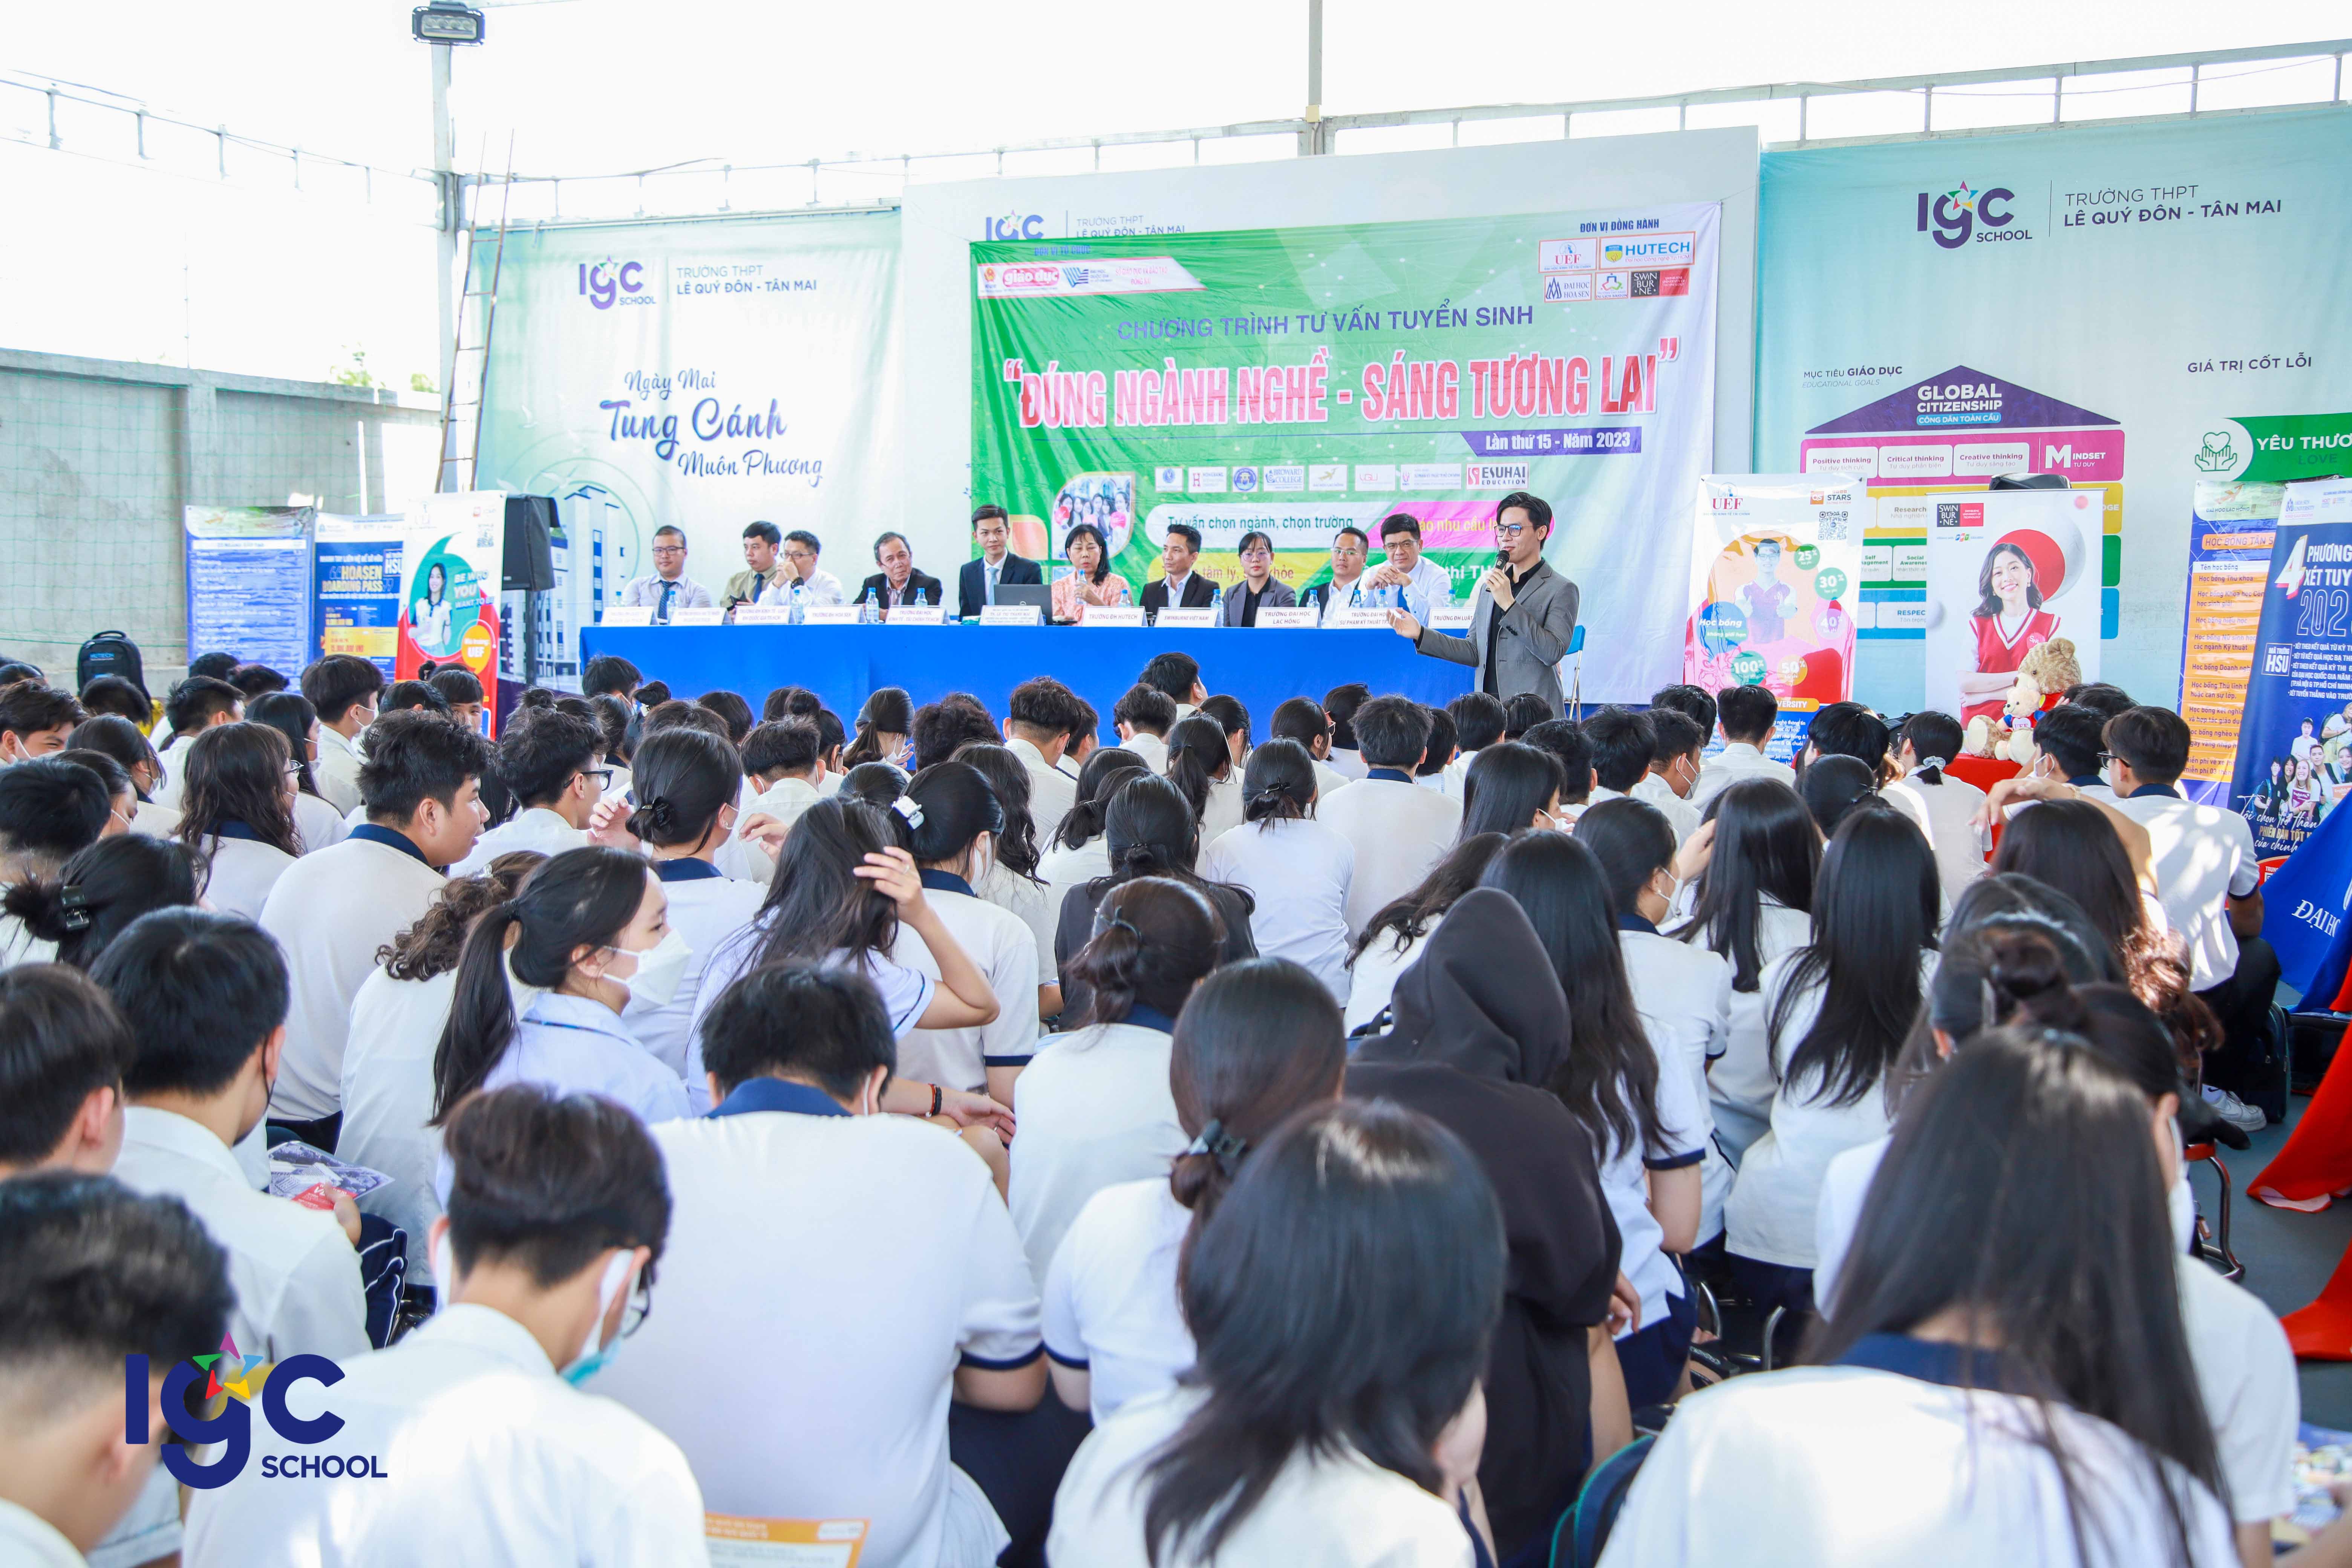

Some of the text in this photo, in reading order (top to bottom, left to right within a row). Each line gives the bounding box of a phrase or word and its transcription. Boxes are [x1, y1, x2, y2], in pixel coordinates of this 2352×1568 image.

[2065, 185, 2199, 207] TRƯỜNG THPT
[2064, 199, 2282, 227] LÊ QUÝ ĐÔN TÂN MAI
[1076, 216, 1144, 227] TRƯỜNG THPT
[1580, 217, 1659, 233] ĐƠN VỊ ĐỒNG HÀNH
[1091, 225, 1184, 238] QUÝ ĐÔN TÂN MAI
[1976, 230, 2032, 242] SCHOOL
[1626, 242, 1690, 256] HUTECH
[1555, 254, 1581, 264] UEF
[677, 265, 763, 278] TRƯỜNG THPT
[677, 279, 816, 294] LÊ QUÝ ĐÔN TÂN MAI
[620, 296, 656, 306] SCHOOL
[1118, 299, 1533, 340] CHƯƠNG TRÌNH TƯ VẤN TUYỂN SINH
[2187, 352, 2311, 373] GIÁ TRỊ CỐT LỖI
[1803, 366, 1902, 380] MỤC TIÊU GIÁO DỤC
[625, 368, 716, 400] Ngày Mai
[1115, 357, 1228, 427] NGÀNH
[1237, 346, 1329, 424] NGHỀ
[1337, 390, 1352, 404] -
[1362, 349, 1459, 421] SÁNG
[1467, 351, 1590, 418] TƯƠNG
[1918, 384, 2001, 400] GLOBAL
[1917, 400, 2002, 413] CITIZENSHIP
[1940, 415, 1958, 423] DÂN
[1960, 413, 1978, 422] TOÀN
[1980, 413, 1998, 422] CẦU
[600, 398, 787, 461] Tung Cánh
[1486, 432, 1630, 450] Lần thứ 15 Năm 2023
[2257, 435, 2294, 451] YÊU
[2298, 454, 2337, 465] LOVE
[678, 449, 822, 487] Muôn Phương
[1482, 467, 1526, 479] ESUHAI
[1712, 498, 1743, 510] UEF
[1209, 515, 1353, 531] chọn ngành, chọn trường
[1438, 514, 1485, 531] nhu cầu
[341, 566, 383, 580] HOASEN
[1203, 566, 1223, 579] tâm
[2274, 534, 2308, 597] 4
[454, 574, 466, 584] BE
[2303, 565, 2323, 586] XÉT
[322, 580, 383, 592] BOARDING PASS
[454, 584, 476, 599] YOU
[455, 600, 474, 608] WANT
[467, 647, 485, 657] UEF
[2323, 654, 2334, 662] HỌC
[2265, 655, 2289, 673] HSU
[2257, 807, 2277, 825] chọn
[2259, 825, 2305, 842] PHIÊN BẢN TỐT
[2254, 838, 2269, 847] của
[2292, 899, 2326, 930] ĐẠI
